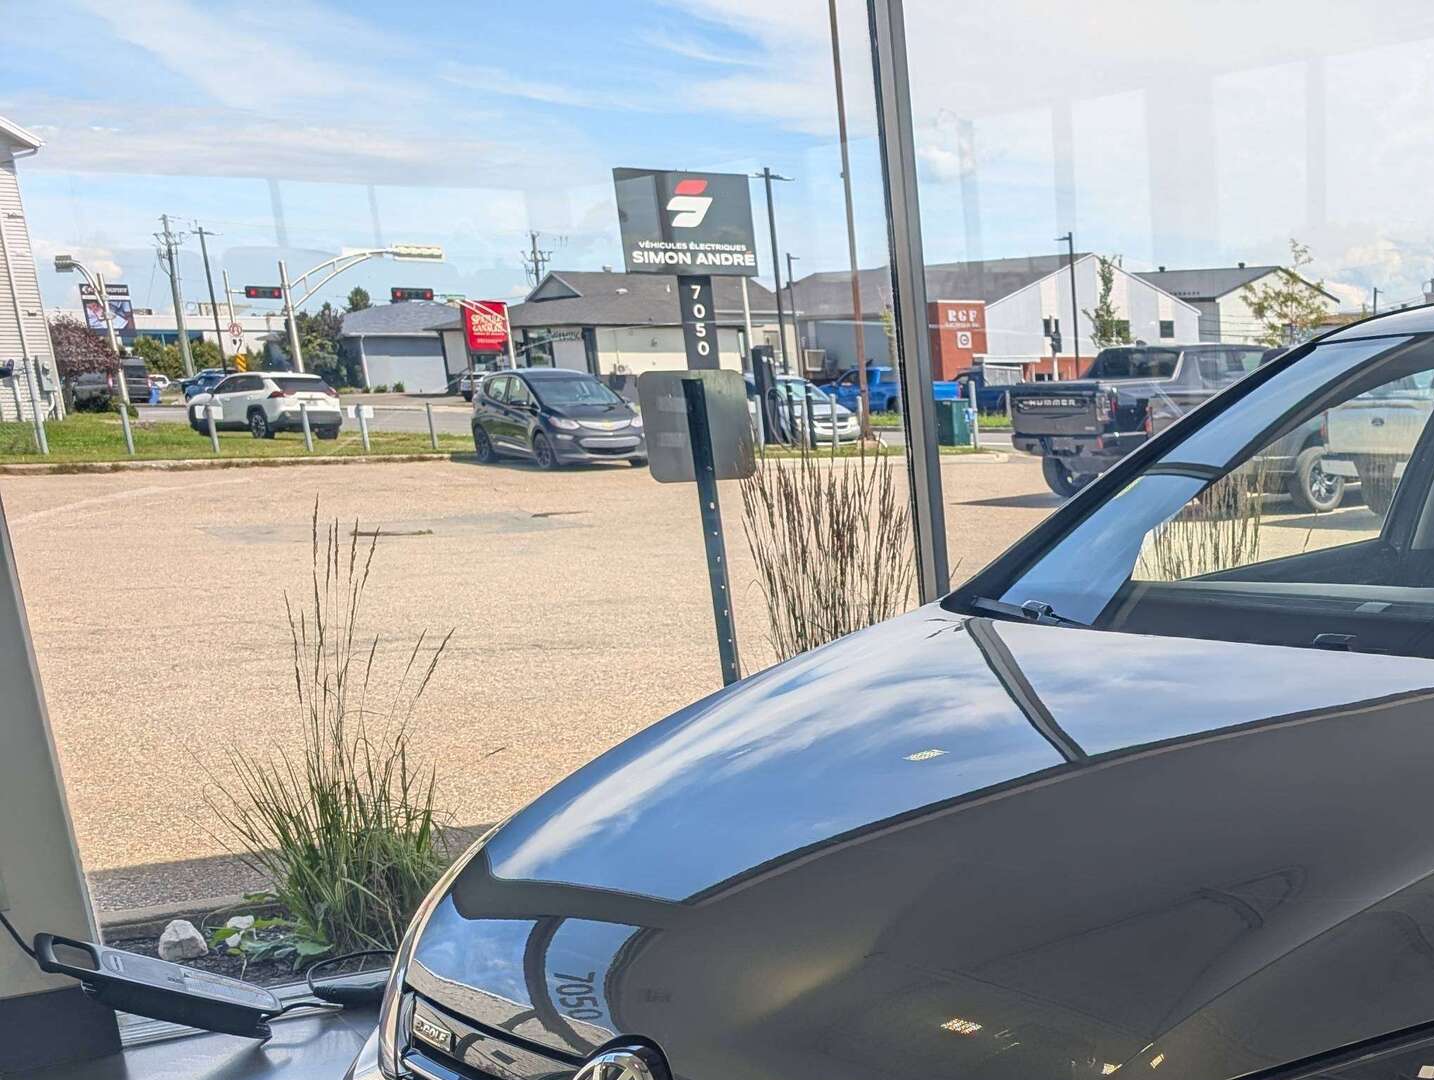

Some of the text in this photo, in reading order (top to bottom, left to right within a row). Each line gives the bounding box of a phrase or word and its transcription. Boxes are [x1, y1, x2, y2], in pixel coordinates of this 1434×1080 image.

[632, 250, 756, 267] SIMON ANDRÉ
[638, 240, 747, 252] VÉHICULES ÉLECTRIQUES
[691, 285, 711, 357] 7050
[553, 971, 604, 1020] 7050
